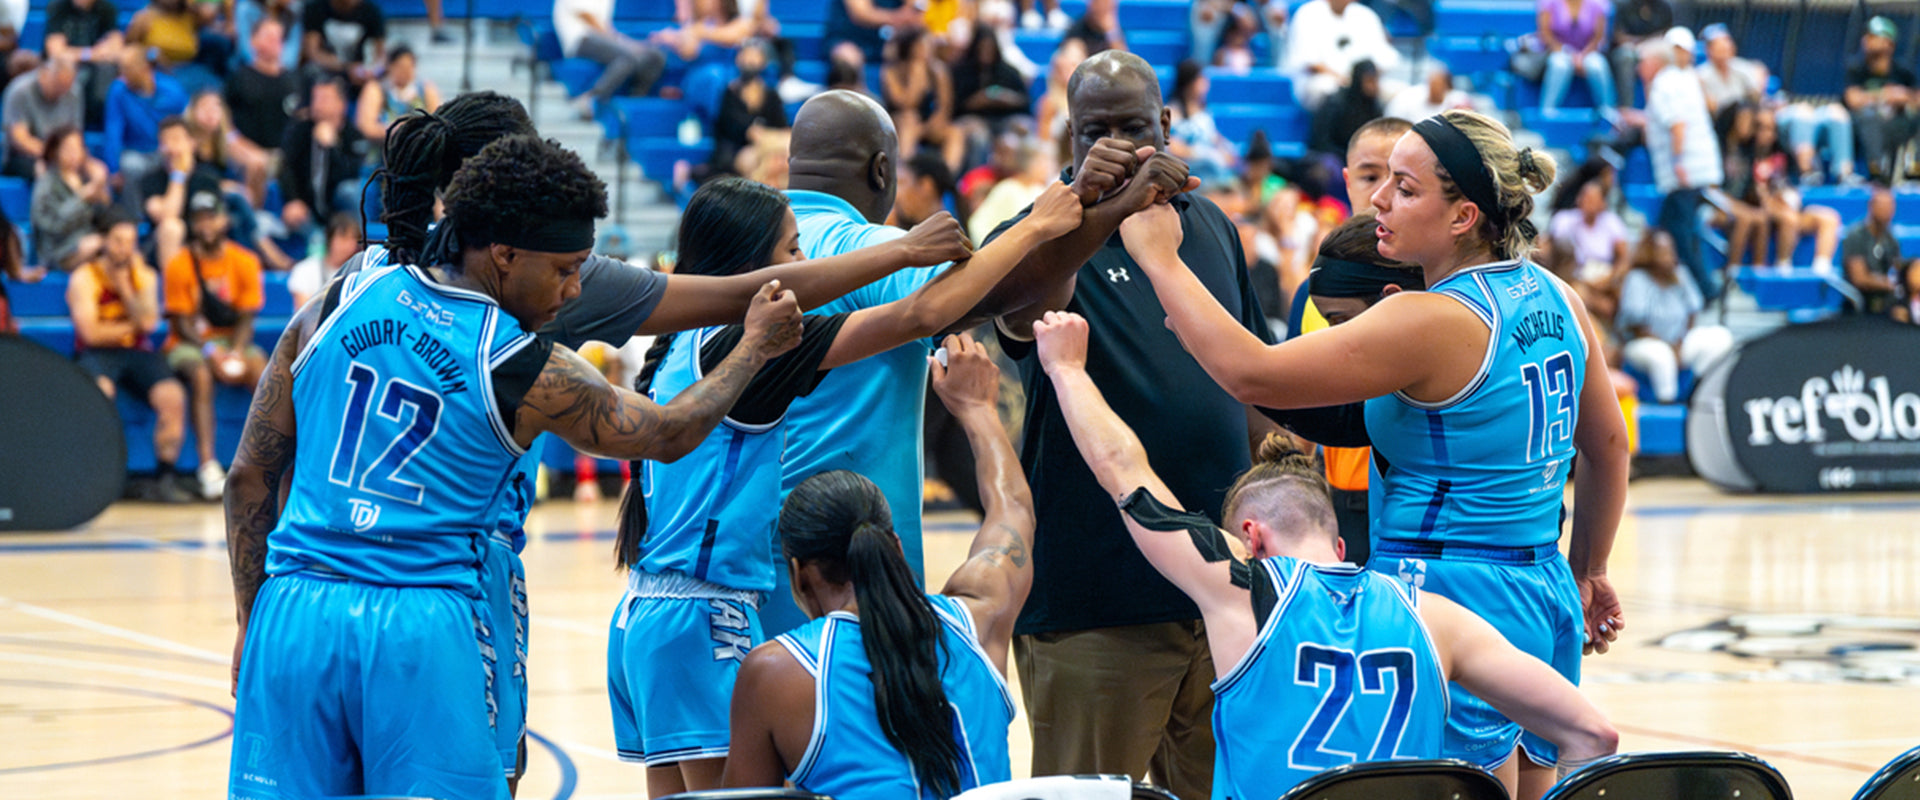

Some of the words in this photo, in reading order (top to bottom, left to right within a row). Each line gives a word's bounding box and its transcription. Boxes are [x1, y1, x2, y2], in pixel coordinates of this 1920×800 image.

[340, 318, 468, 396] GUIDRY-BROWN
[1511, 310, 1565, 355] MICHELIS
[328, 360, 445, 506] 12
[1520, 350, 1577, 464] 13
[1287, 641, 1418, 771] 22
